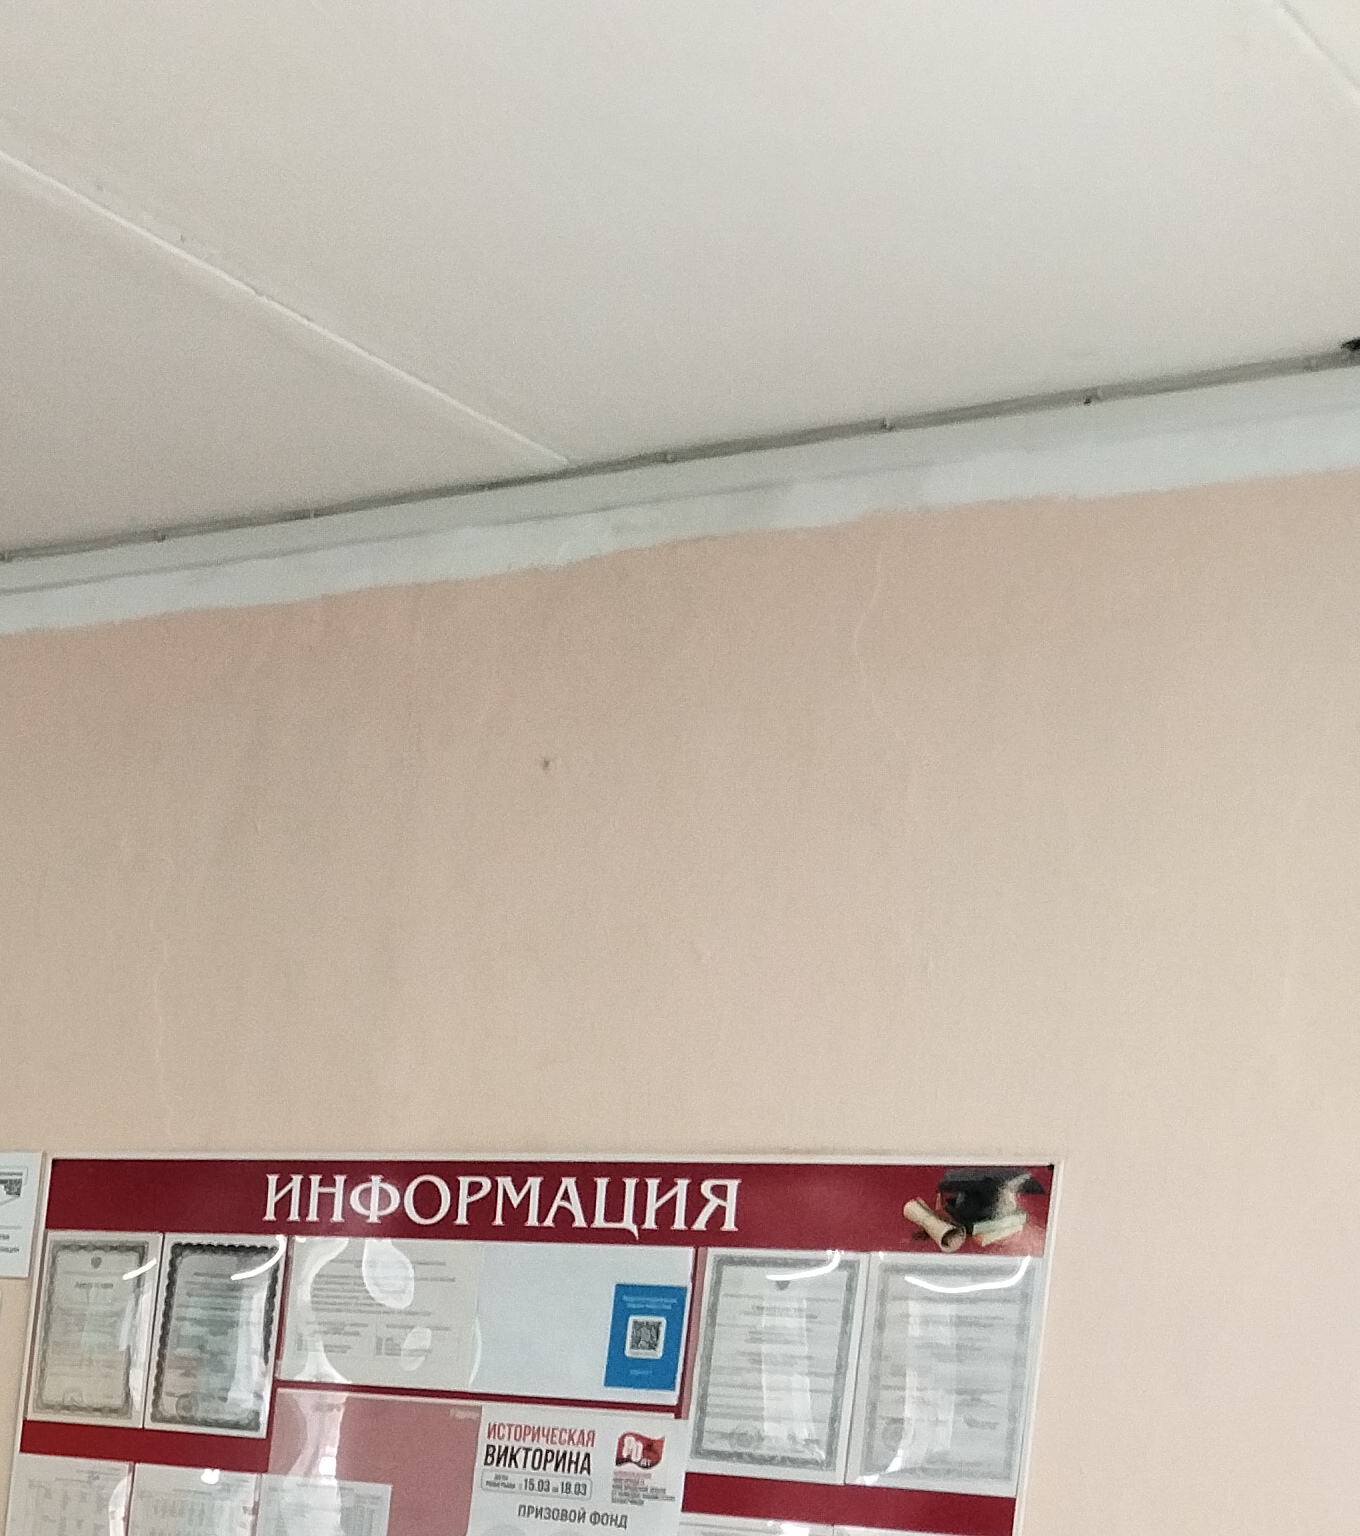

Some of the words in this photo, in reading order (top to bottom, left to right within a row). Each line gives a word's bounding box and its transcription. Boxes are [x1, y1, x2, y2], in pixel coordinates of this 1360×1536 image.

[262, 1173, 743, 1240] ИНФОРМАЦИЯ
[487, 1421, 596, 1448] ИСТОРИЧЕСКАЯ
[483, 1443, 592, 1476] ВИКТОРИНА
[518, 1503, 586, 1524] ПРИЗОВОЙ
[589, 1508, 629, 1531] ФОНД
